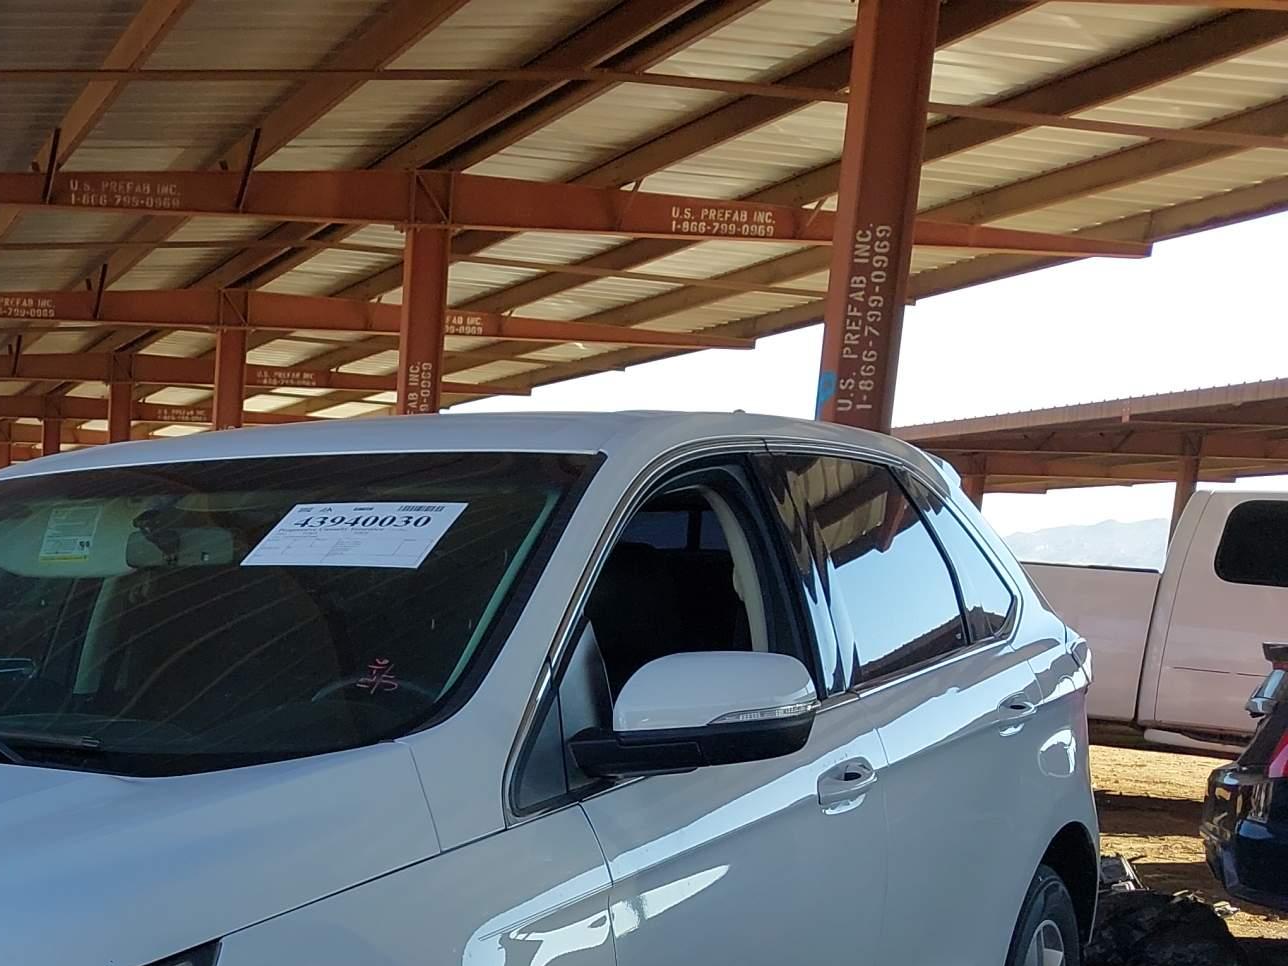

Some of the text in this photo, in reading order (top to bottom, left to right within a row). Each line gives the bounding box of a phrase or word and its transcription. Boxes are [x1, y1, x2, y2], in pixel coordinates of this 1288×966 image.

[102, 180, 151, 195] PREFAB
[671, 206, 776, 225] U.S. PREFAB INC.
[671, 220, 775, 237] 1-866-799-0969
[836, 223, 874, 412] U.S. PREFAB INC.
[856, 225, 893, 410] 1-866-799-0969
[293, 515, 432, 528] 43940030
